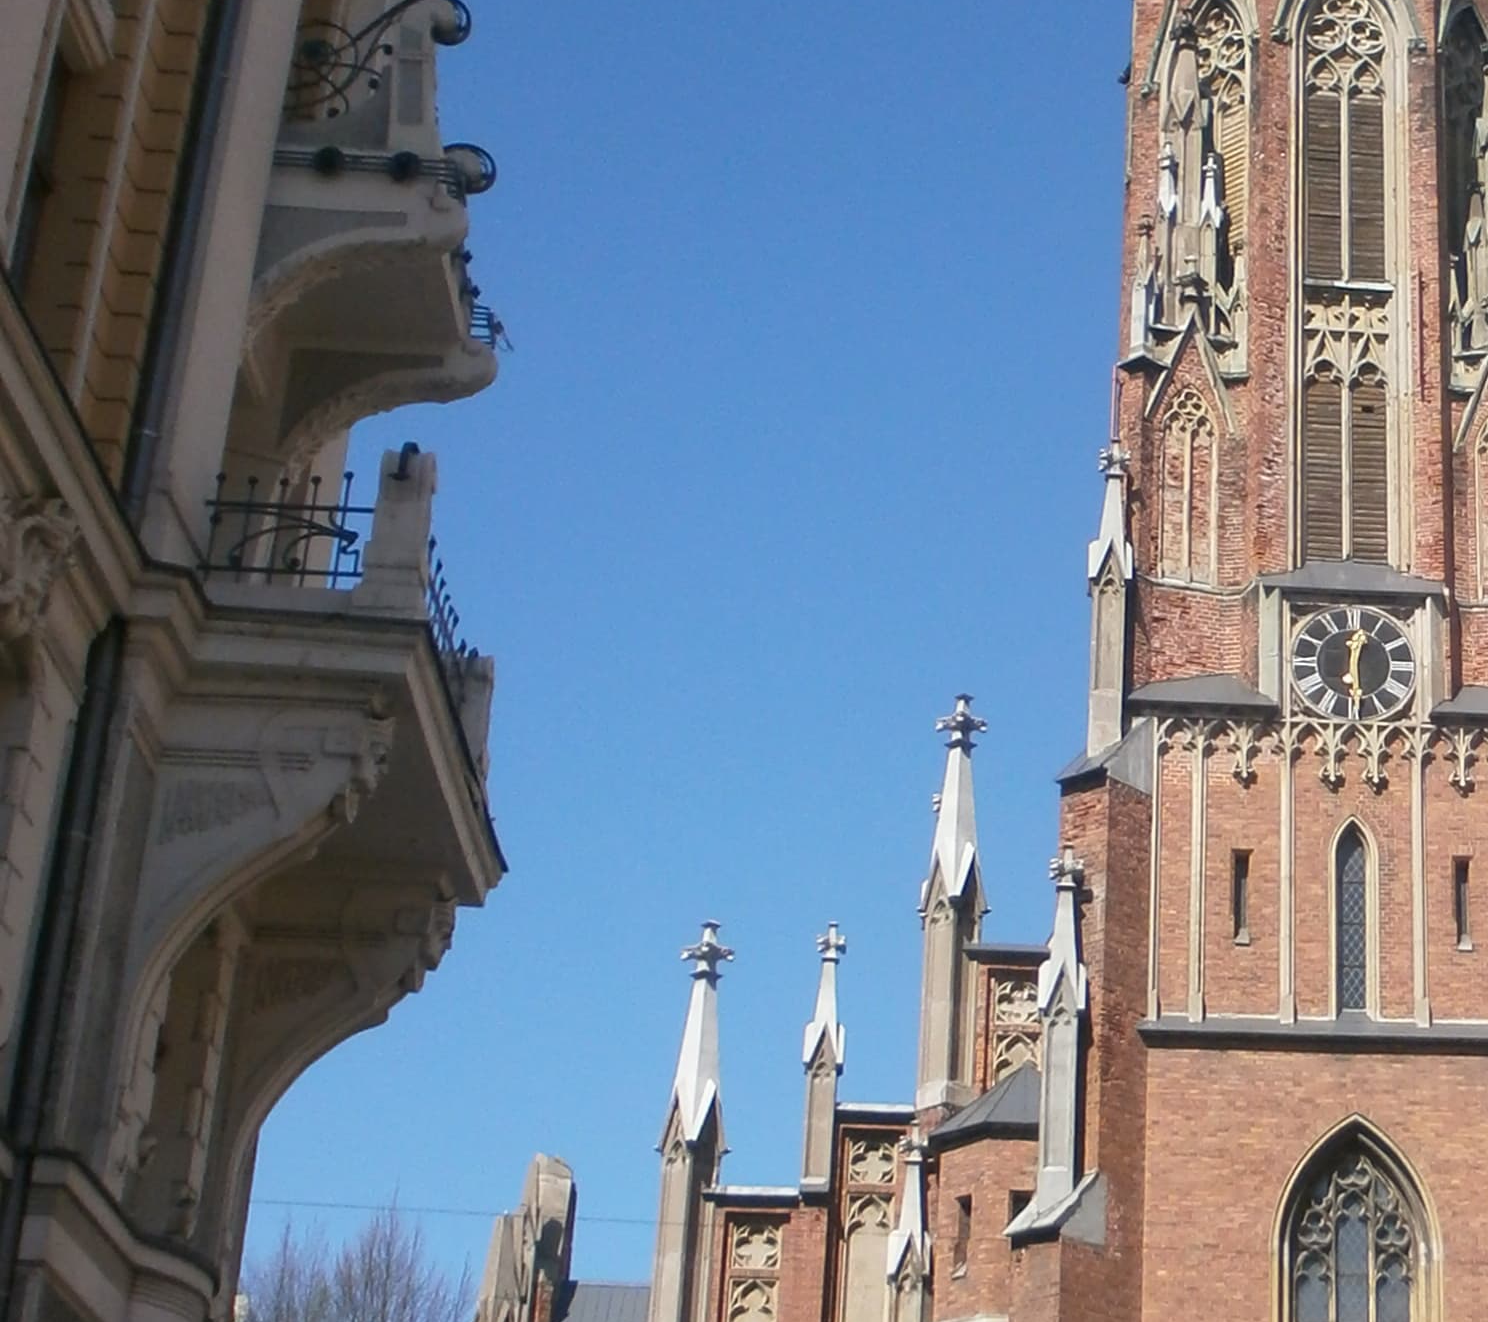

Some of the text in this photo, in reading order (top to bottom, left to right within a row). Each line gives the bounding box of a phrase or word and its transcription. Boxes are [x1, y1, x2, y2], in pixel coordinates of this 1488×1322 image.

[1346, 609, 1361, 630] XII
[1371, 617, 1385, 637] I
[1384, 636, 1408, 652] II
[1371, 694, 1388, 714] V
